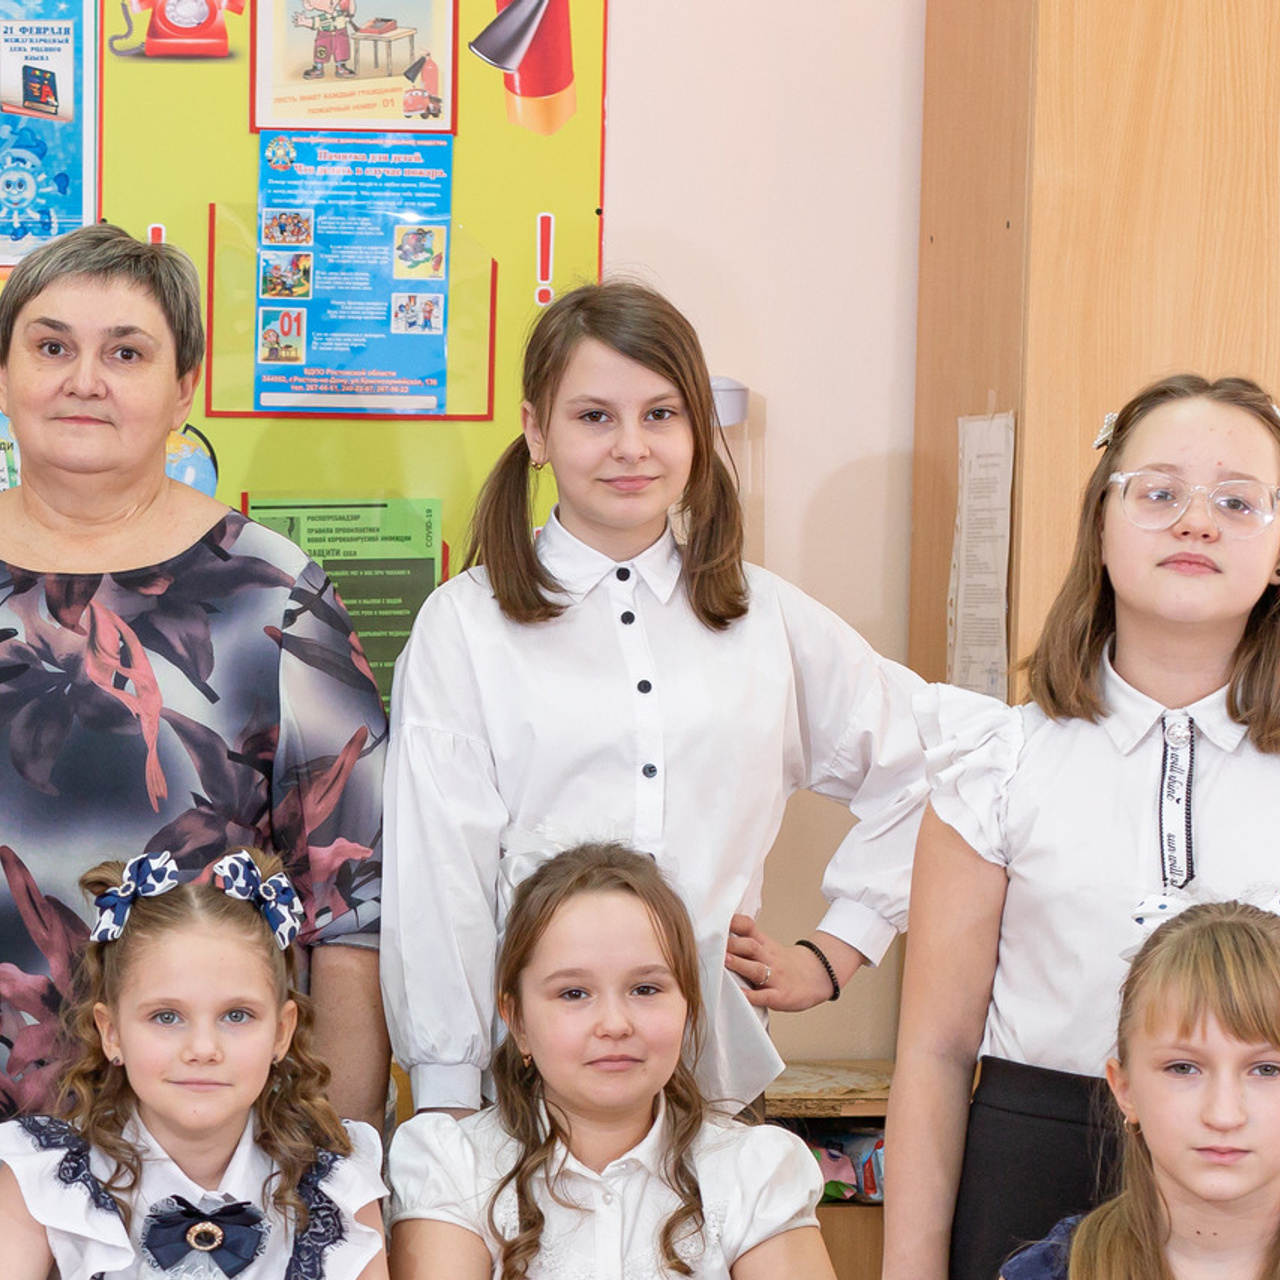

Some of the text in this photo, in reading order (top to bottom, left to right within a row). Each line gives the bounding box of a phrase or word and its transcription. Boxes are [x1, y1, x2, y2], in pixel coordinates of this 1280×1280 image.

[3, 26, 71, 35] 21 ФЕВРАЛЯ
[382, 98, 395, 108] 01
[317, 150, 424, 164] Памятка для детей.
[294, 163, 315, 176] Что
[355, 167, 363, 176] в
[365, 168, 402, 179] случае
[279, 311, 302, 338] 01
[425, 509, 433, 548] COVID-19
